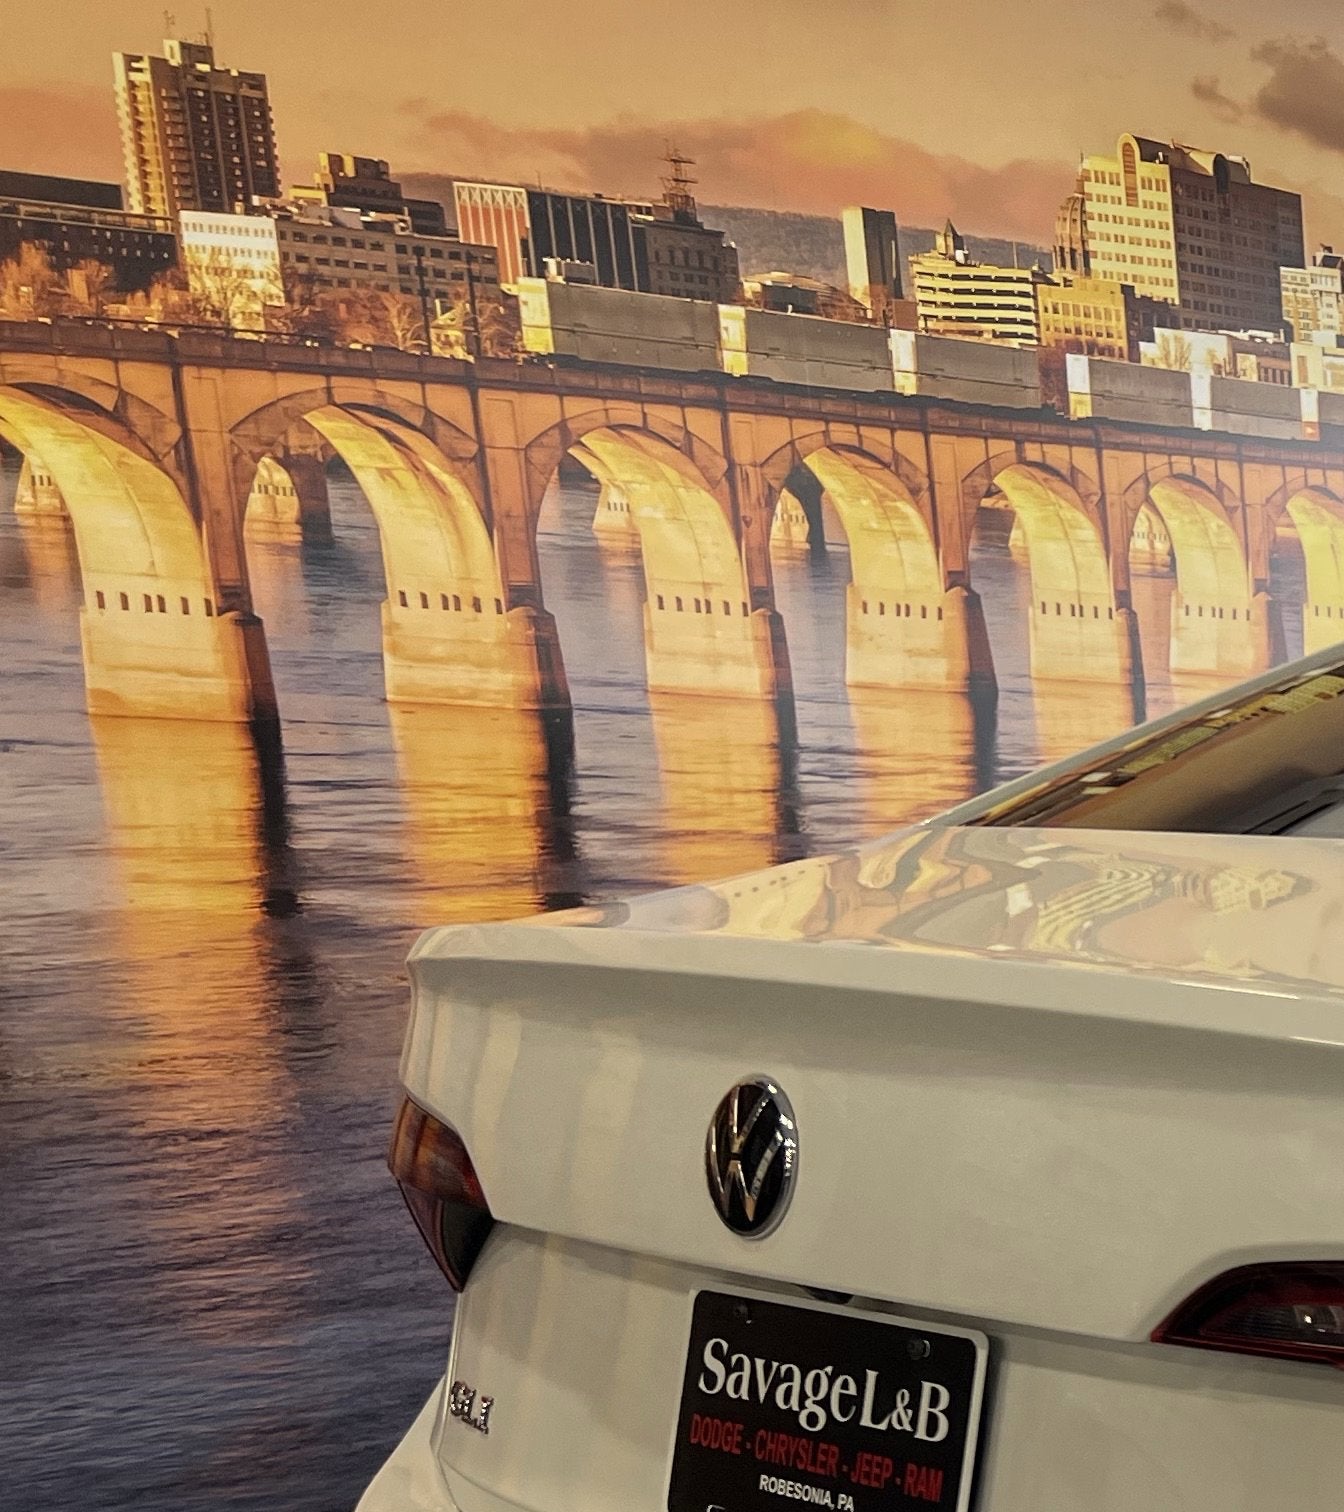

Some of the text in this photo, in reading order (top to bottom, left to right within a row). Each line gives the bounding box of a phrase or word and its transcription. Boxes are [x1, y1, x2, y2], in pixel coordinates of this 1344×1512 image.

[690, 1413, 744, 1455] DODGE
[754, 1429, 839, 1477] CHRYSLER
[850, 1453, 893, 1489] JEEP
[903, 1463, 944, 1503] RAM
[759, 1474, 855, 1512] ROBESONIA, PA
